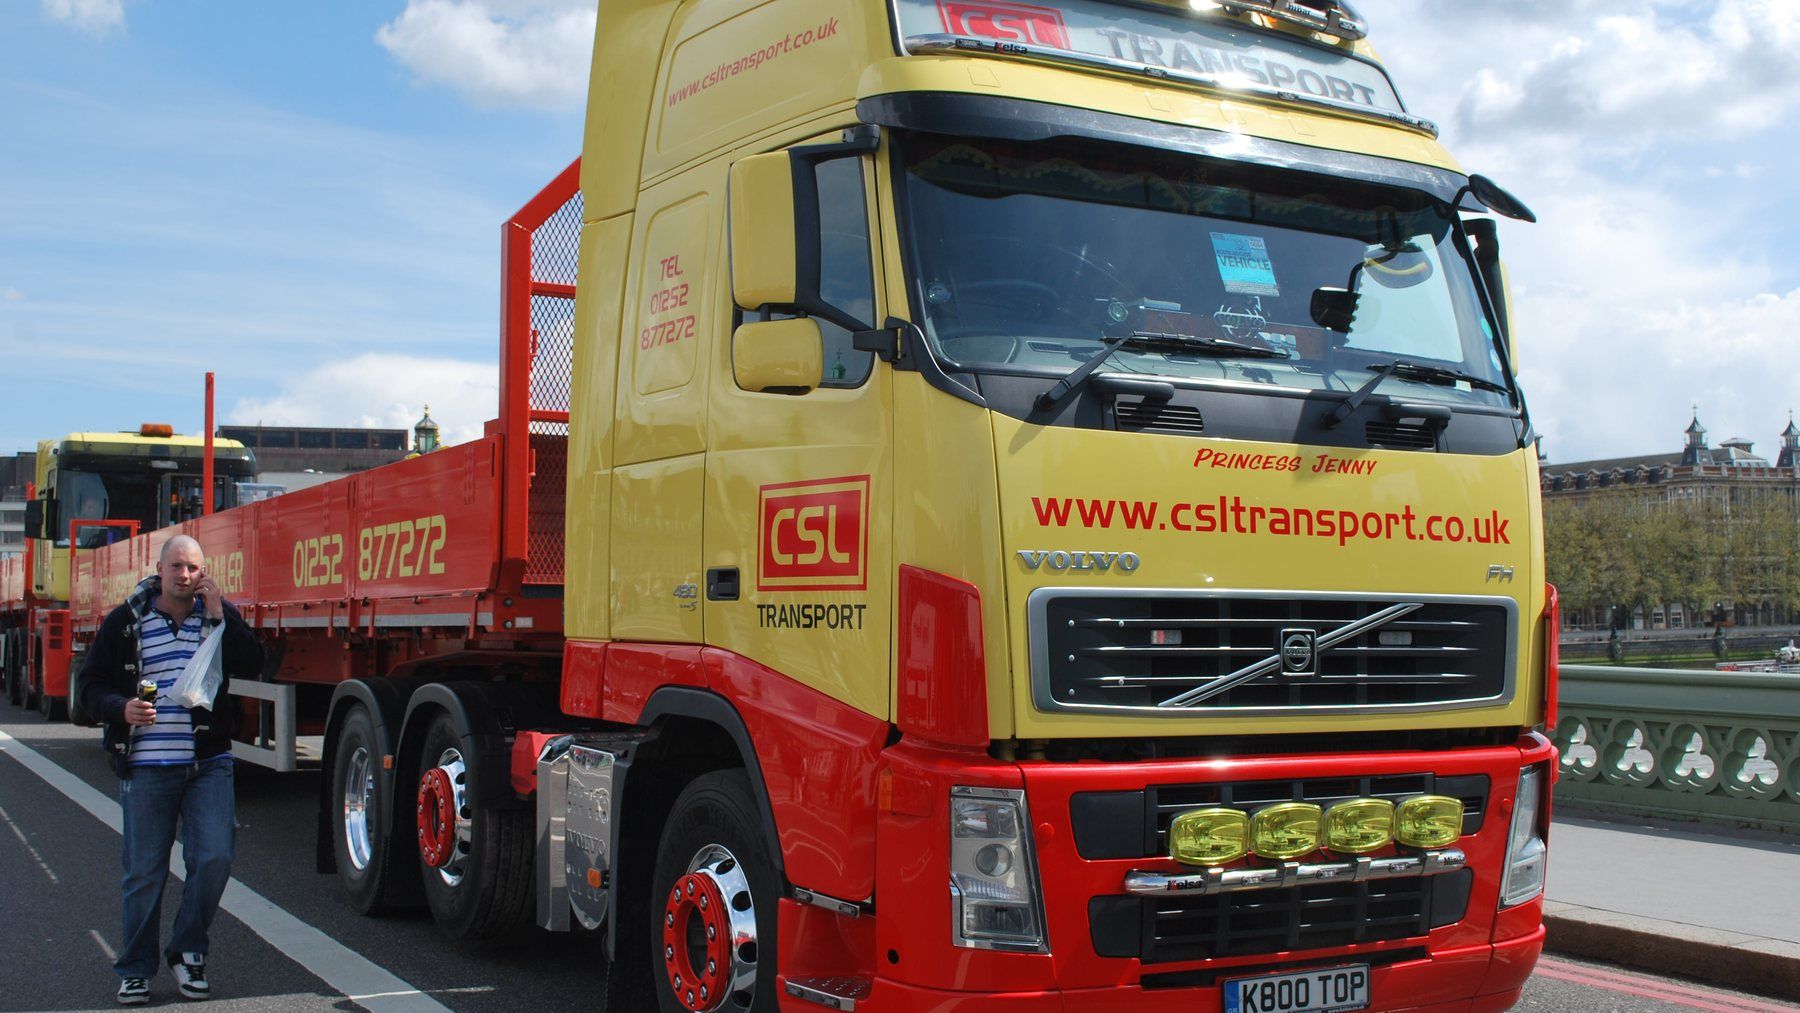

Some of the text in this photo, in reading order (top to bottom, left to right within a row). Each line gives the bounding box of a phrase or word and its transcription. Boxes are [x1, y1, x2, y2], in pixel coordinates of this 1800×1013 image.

[960, 11, 1057, 47] CSL
[669, 17, 839, 108] www.csltransport.co.uk
[994, 42, 1028, 54] Kelsa
[1096, 30, 1375, 106] TRANSPORT
[661, 255, 684, 281] TEL.
[1217, 255, 1271, 271] VEHICLE
[650, 284, 689, 315] 01252
[641, 316, 696, 350] 877272
[1193, 448, 1378, 476] PRINCESS JENNY
[771, 504, 850, 566] CSL
[1031, 496, 1511, 546] www.csltransport.co.uk
[293, 514, 447, 588] 01252 877272
[1016, 549, 1140, 571] VOLVO
[1486, 564, 1514, 584] FH
[757, 604, 867, 630] TRANSPORT
[1242, 971, 1365, 1013] K800 TOP
